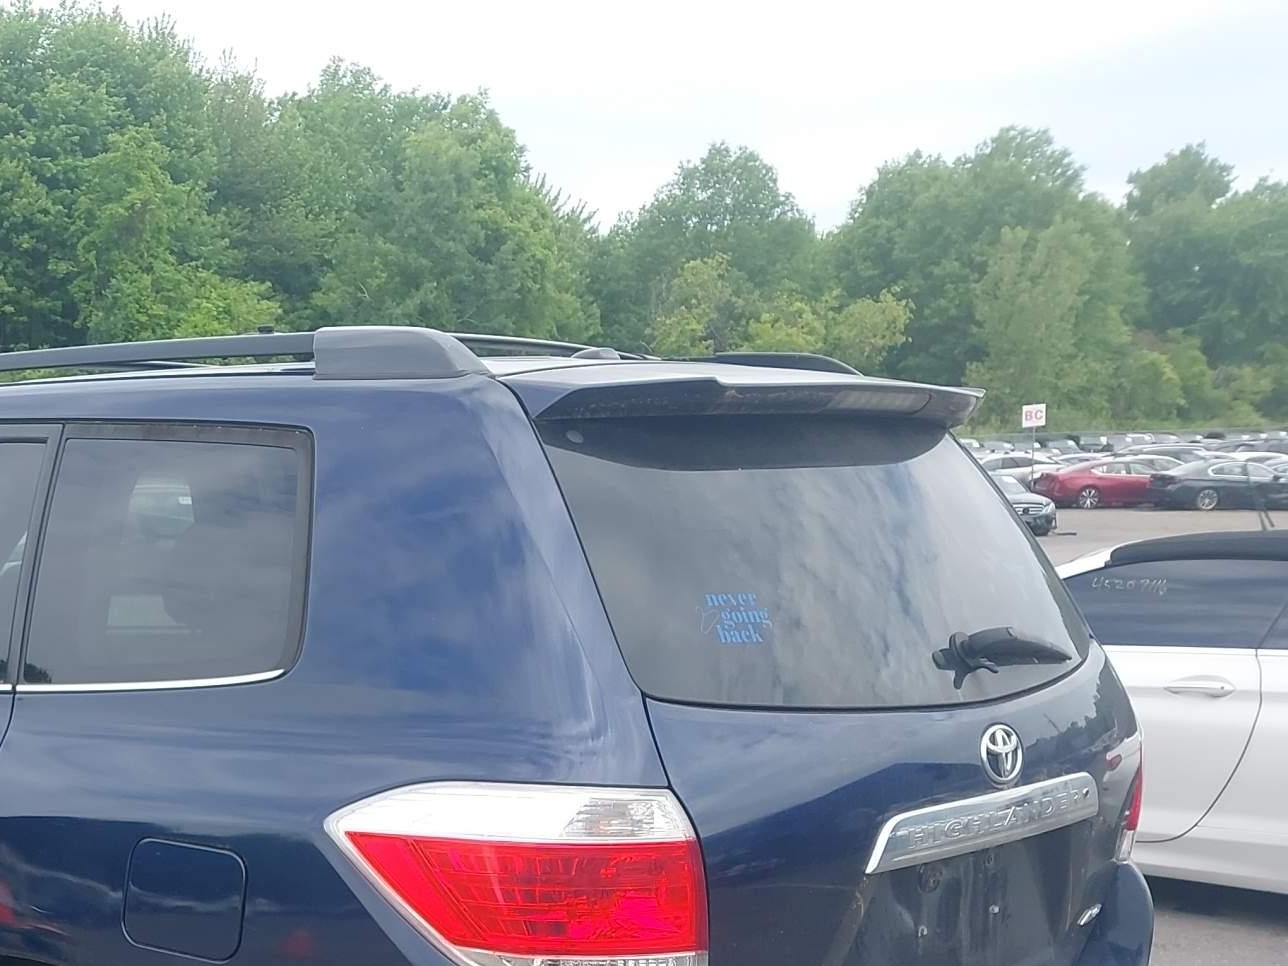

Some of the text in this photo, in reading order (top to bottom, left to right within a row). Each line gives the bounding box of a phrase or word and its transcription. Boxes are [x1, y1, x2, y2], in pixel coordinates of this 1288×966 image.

[705, 593, 757, 606] never
[721, 607, 773, 629] going
[716, 624, 764, 643] back
[908, 788, 1082, 848] HIGHLANDER
